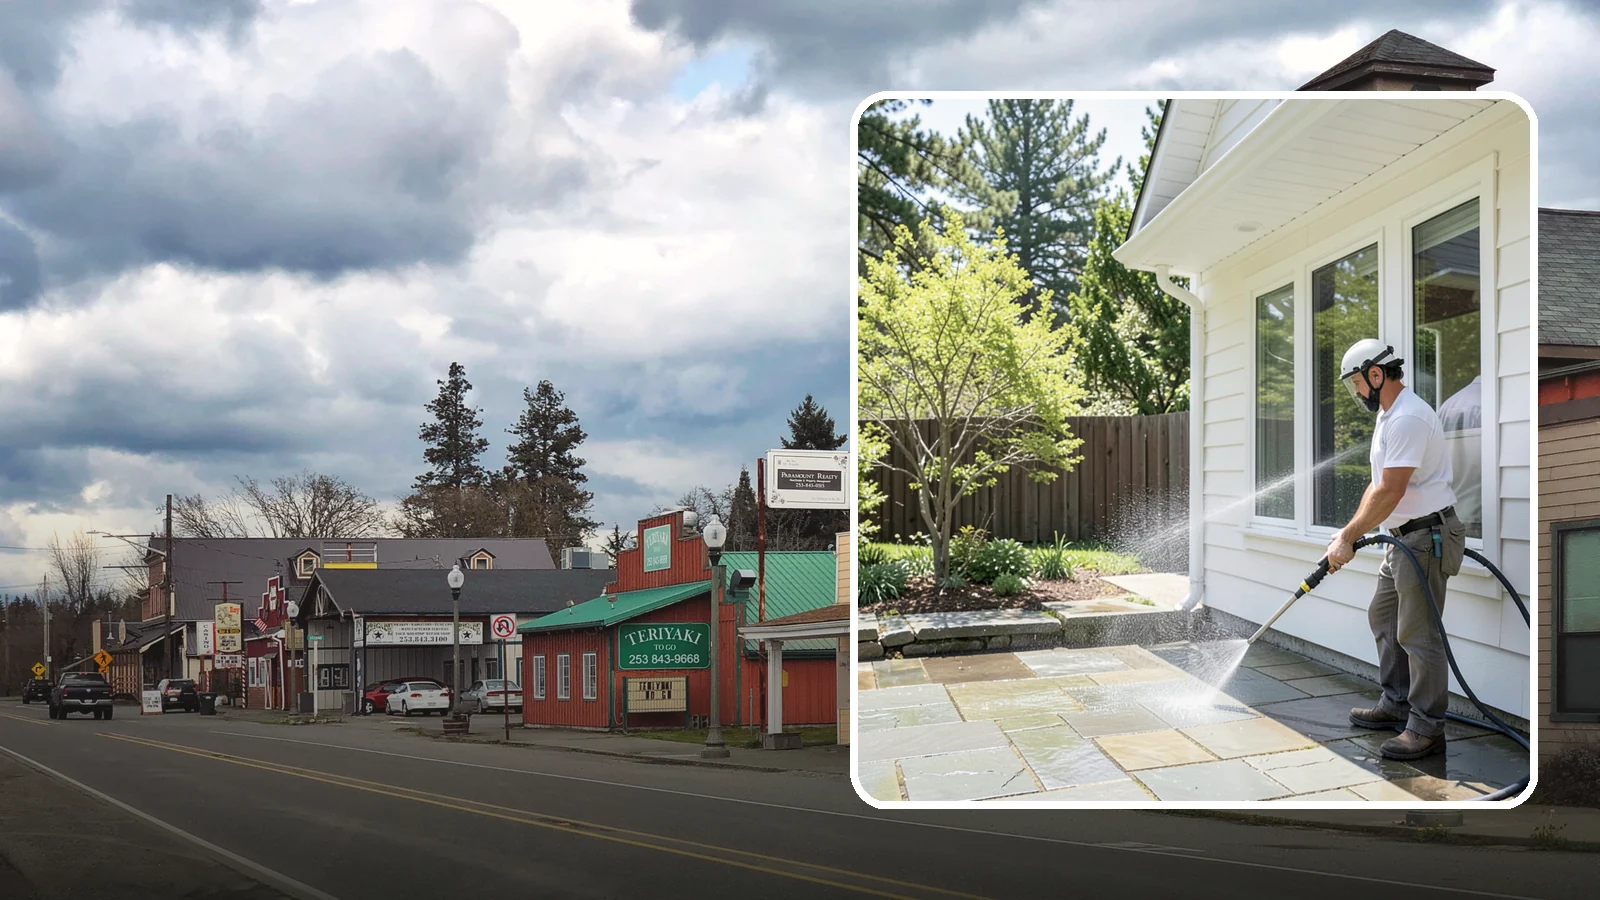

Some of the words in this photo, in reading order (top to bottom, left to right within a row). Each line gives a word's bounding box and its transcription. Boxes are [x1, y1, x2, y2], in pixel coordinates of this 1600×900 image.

[625, 628, 702, 646] TERIYAKI
[629, 655, 648, 664] 253
[652, 654, 700, 664] 843-9668
[639, 681, 672, 690] TERIYAKI
[662, 690, 671, 699] GO
